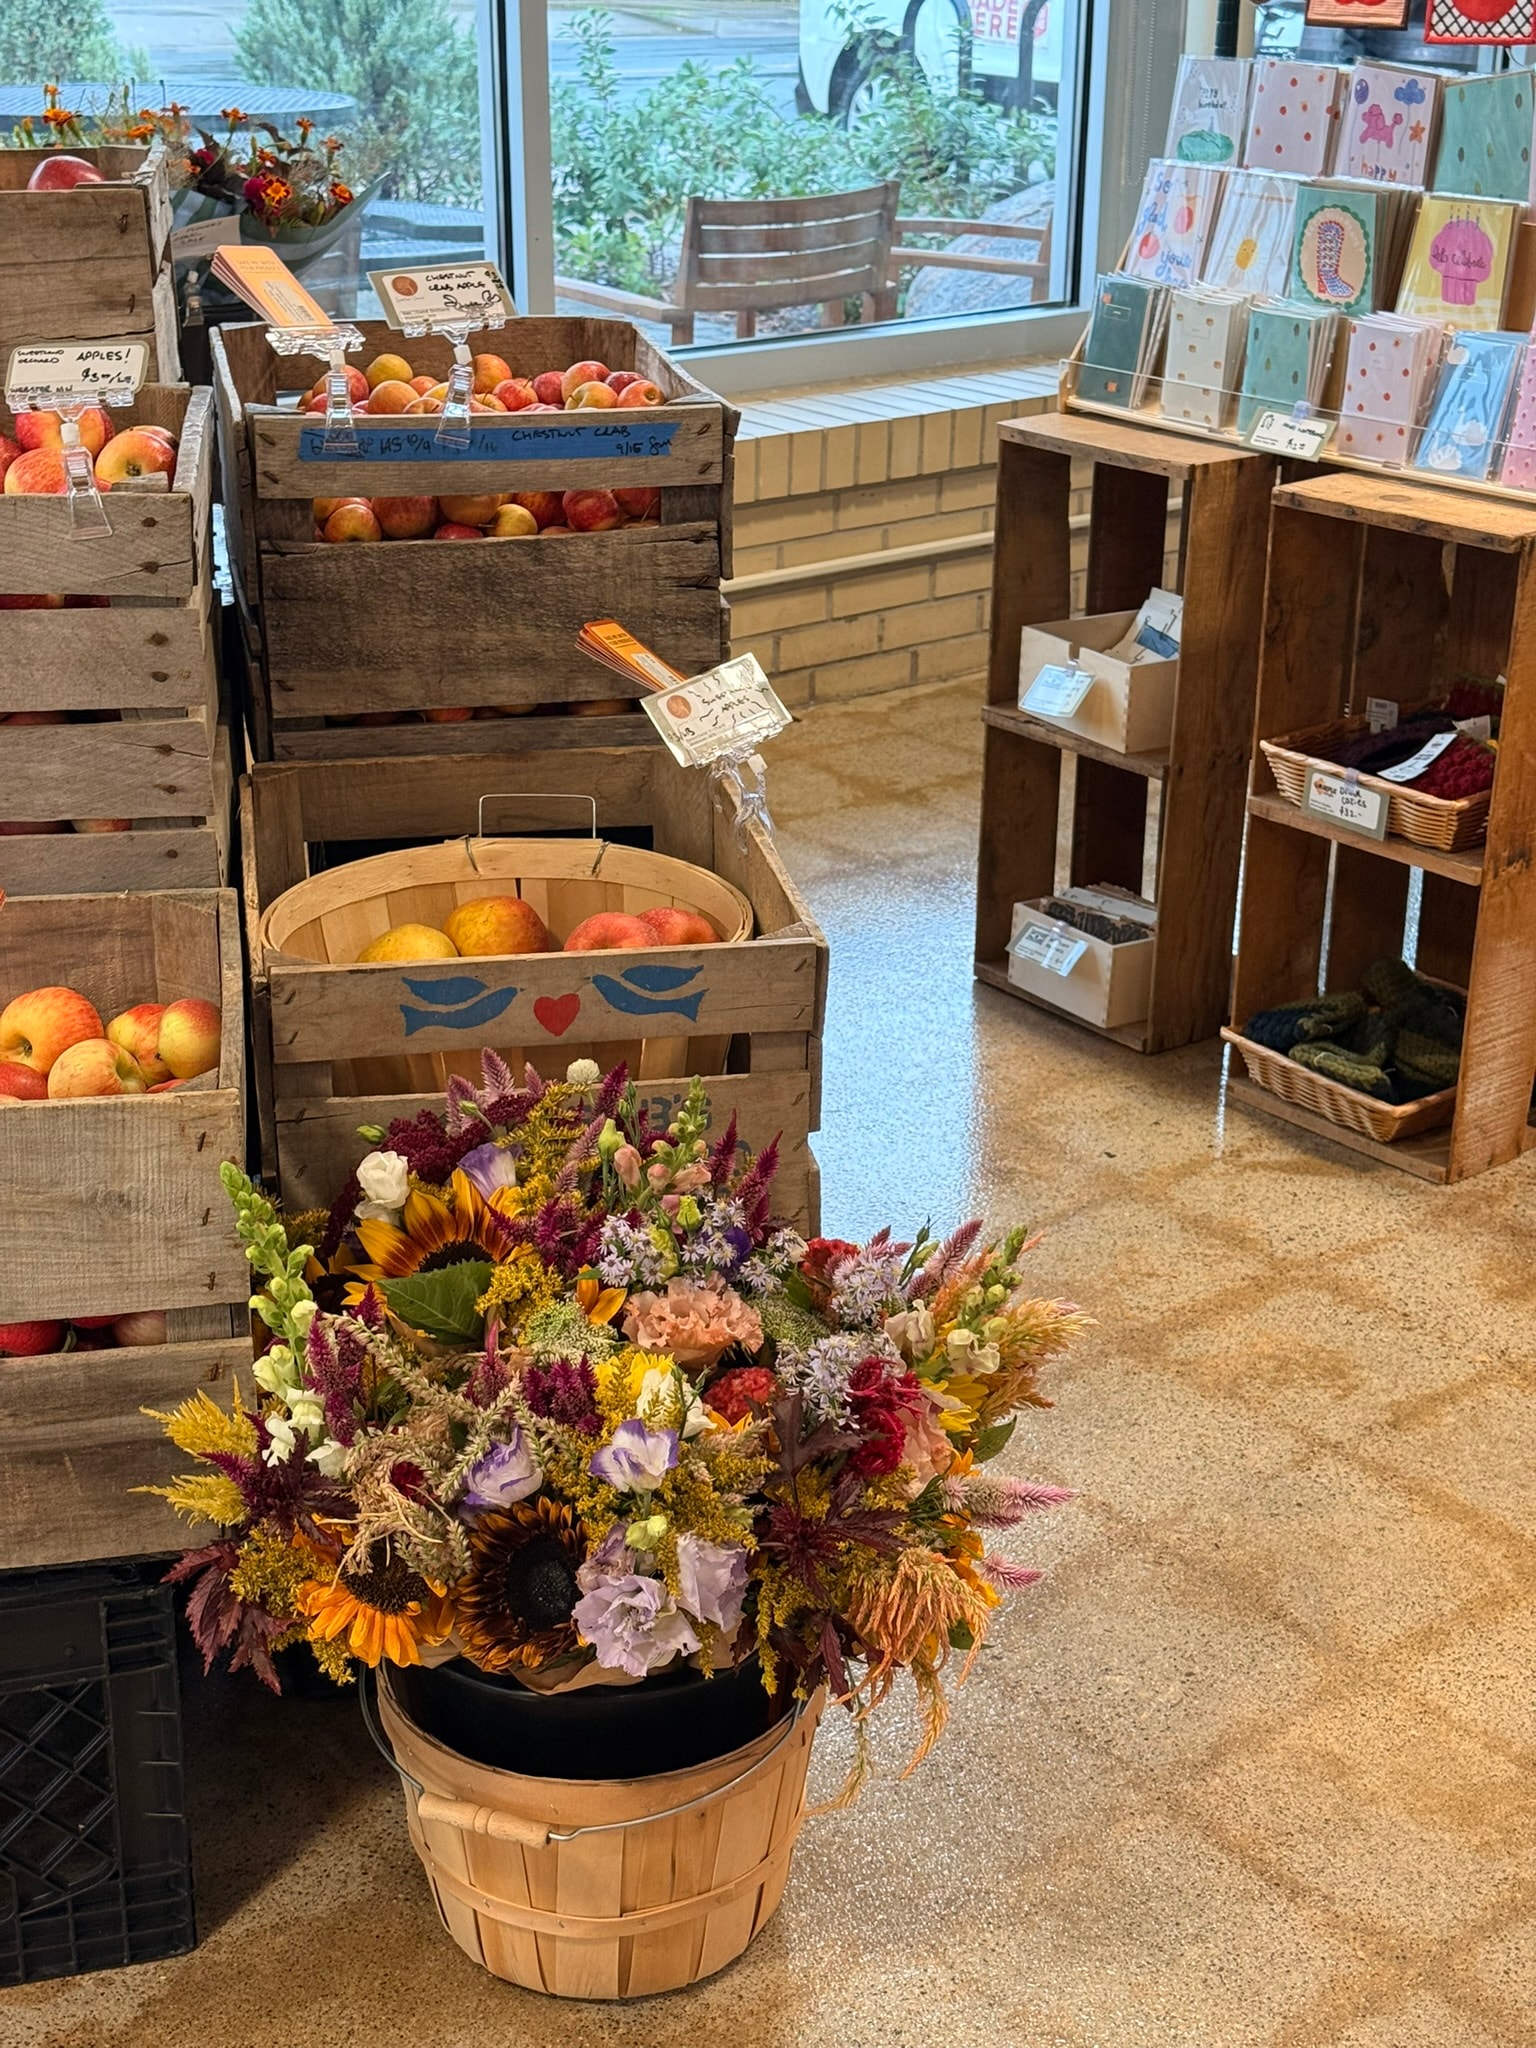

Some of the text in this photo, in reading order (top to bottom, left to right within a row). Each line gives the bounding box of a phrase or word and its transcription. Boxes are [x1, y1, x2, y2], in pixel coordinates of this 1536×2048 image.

[973, 12, 1018, 39] ERE
[1360, 155, 1397, 182] happy
[76, 347, 131, 364] APPLES!
[511, 427, 588, 441] CHESTNUT
